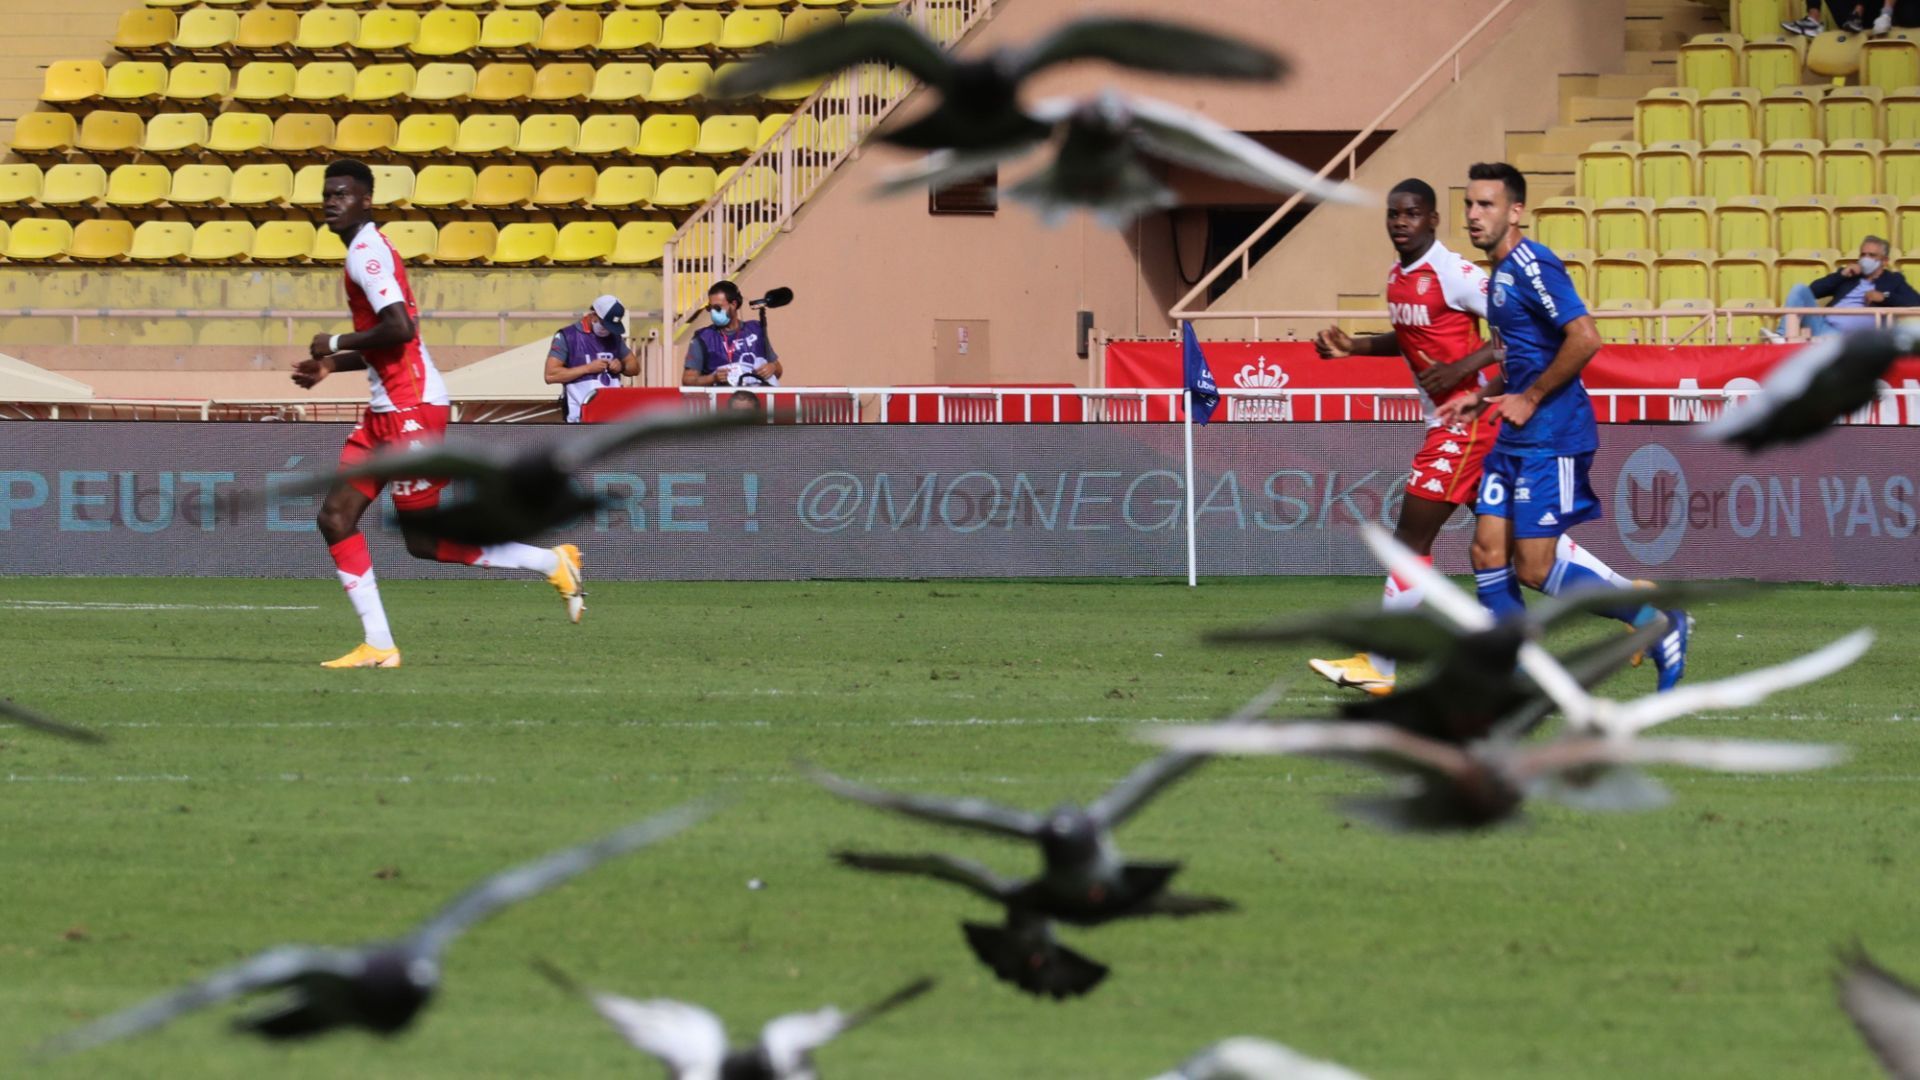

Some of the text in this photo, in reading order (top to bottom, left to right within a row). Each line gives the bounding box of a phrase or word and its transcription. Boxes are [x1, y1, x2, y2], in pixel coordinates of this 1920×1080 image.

[0, 472, 236, 533] PEUT
[1630, 475, 1726, 530] Uber
[1728, 474, 1802, 538] ON
